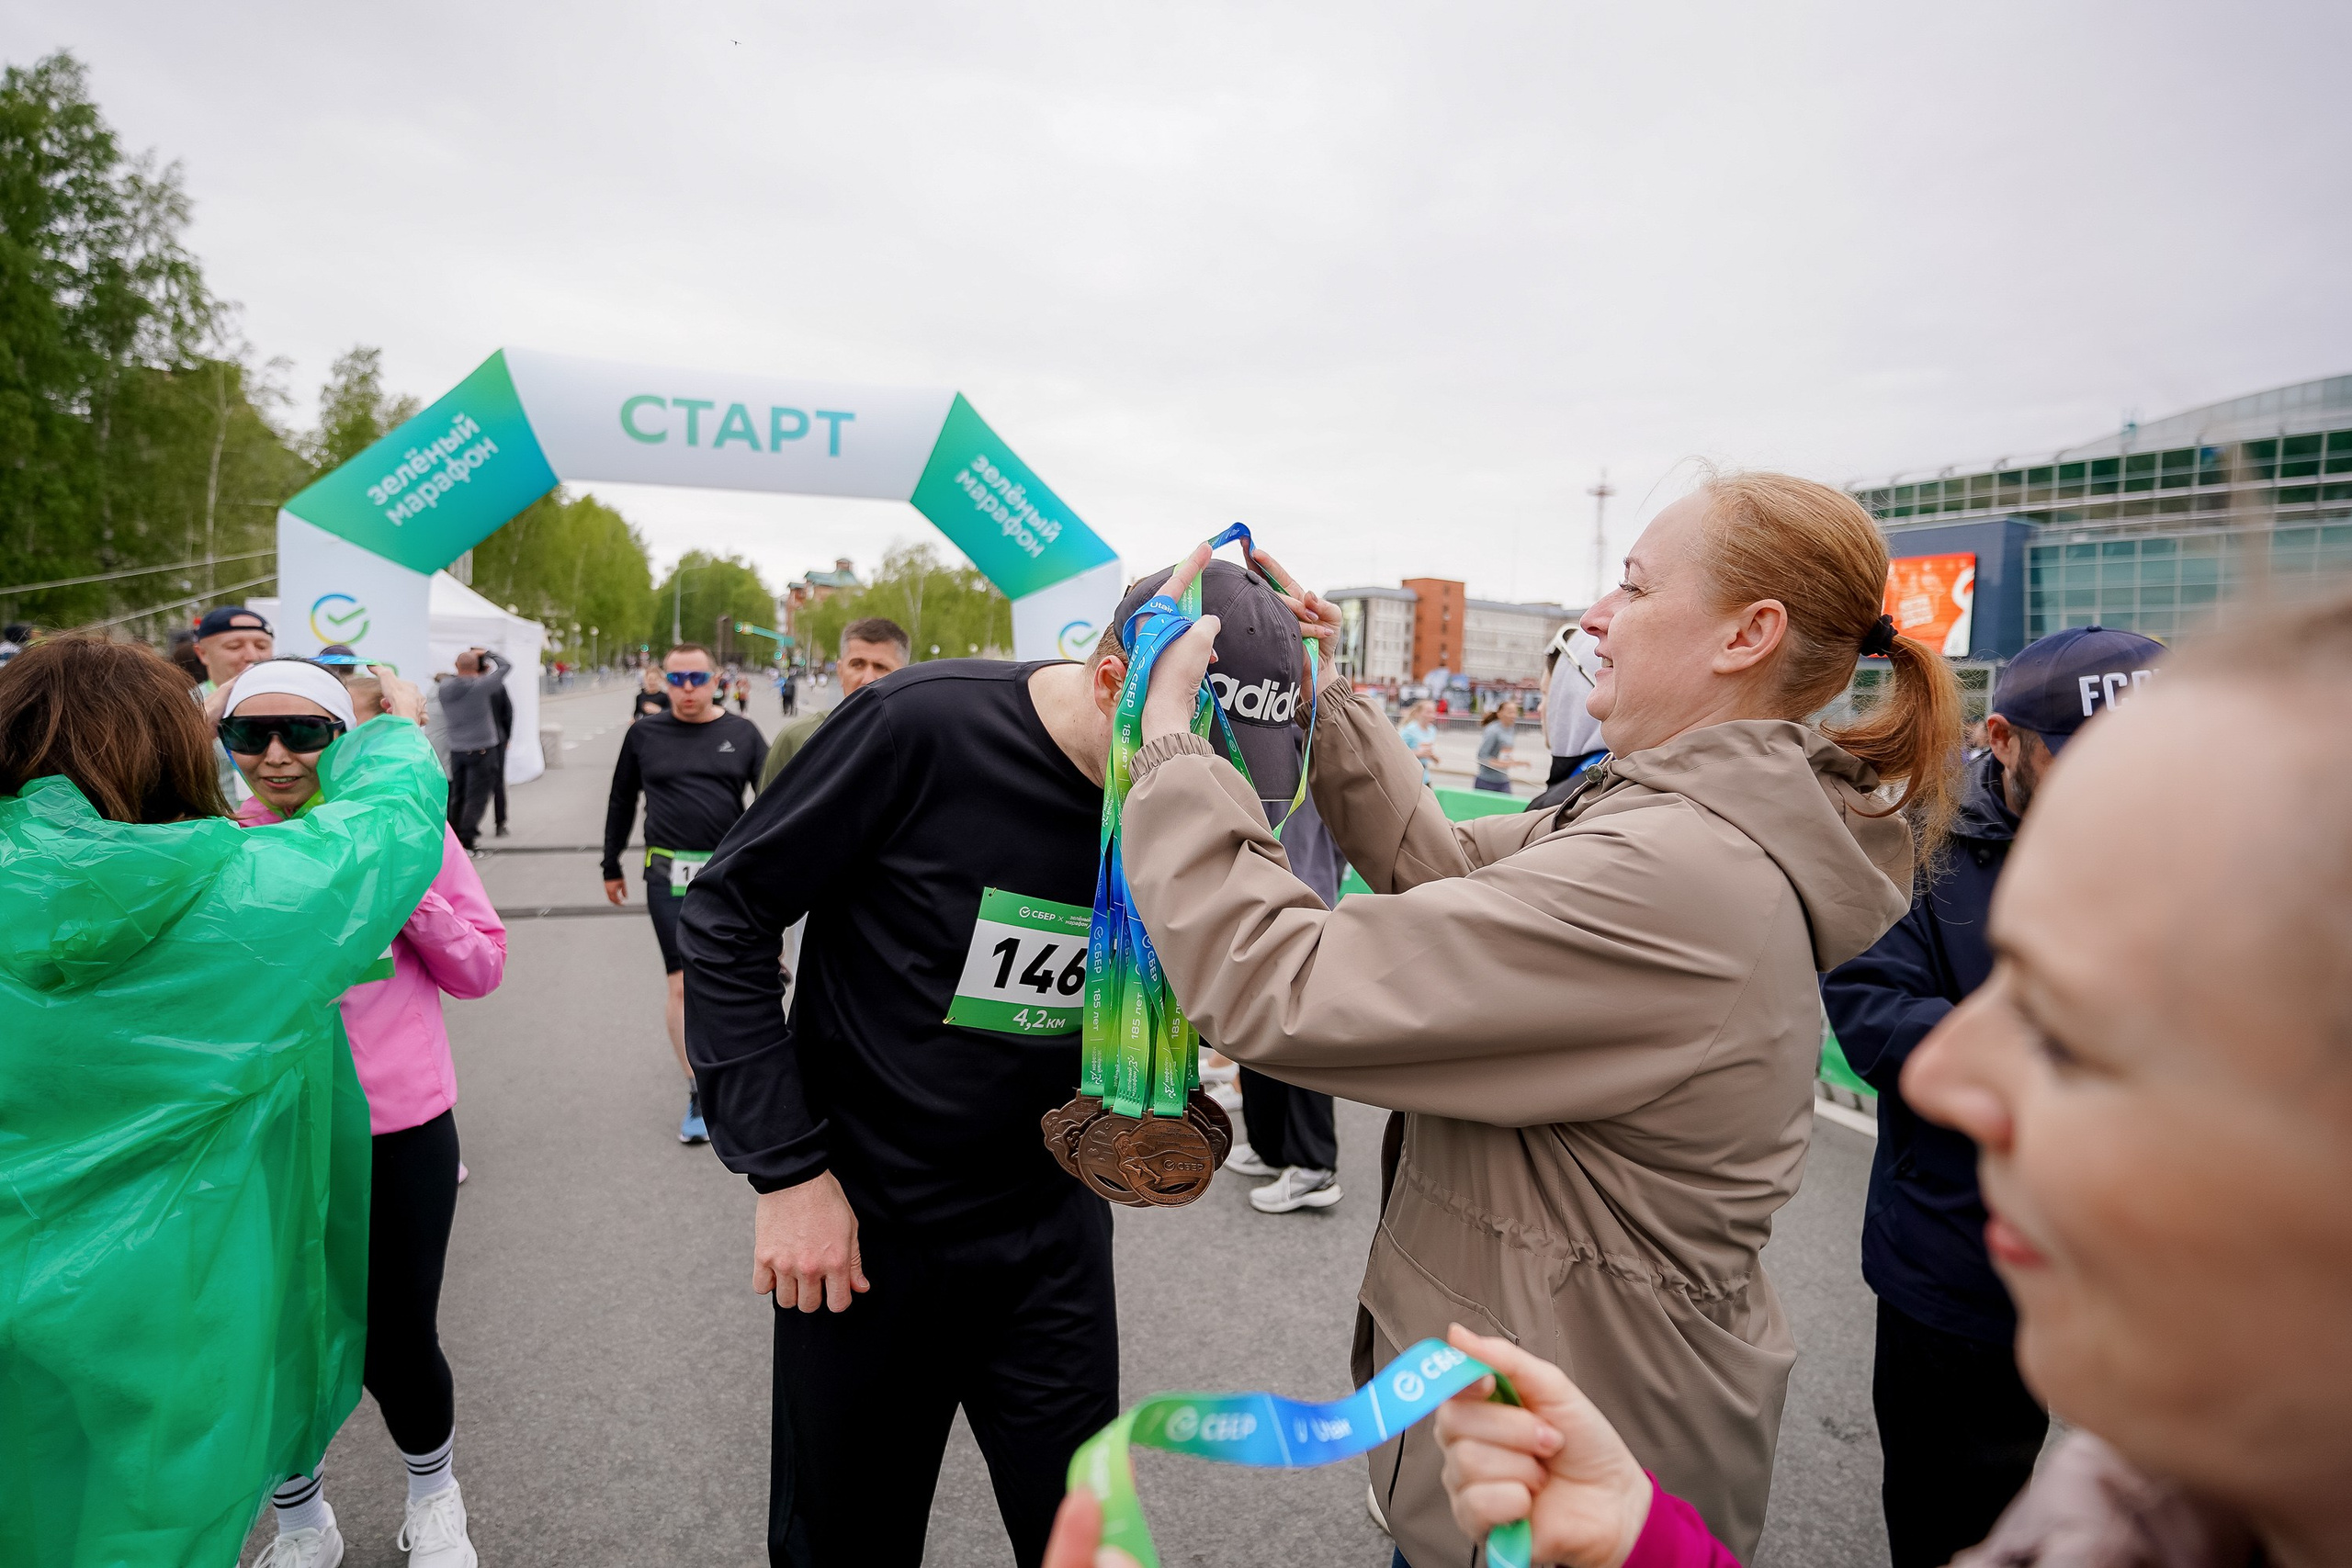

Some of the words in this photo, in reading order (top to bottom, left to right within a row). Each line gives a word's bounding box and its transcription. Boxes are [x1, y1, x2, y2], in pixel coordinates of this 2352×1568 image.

[620, 395, 855, 457] СТАРТ
[367, 412, 481, 506] зелёный
[386, 436, 500, 527] марафон
[955, 468, 1046, 558] марафон
[970, 454, 1063, 544] зелёный
[1149, 601, 1174, 615] Utair
[1125, 673, 1139, 709] СБЕР
[2078, 668, 2161, 717] FC
[1121, 722, 1132, 745] 185
[1121, 746, 1130, 772] лет
[1031, 909, 1057, 921] СБЕР
[991, 937, 1089, 997] 146
[1093, 942, 1102, 974] СБЕР
[1147, 950, 1158, 982] СБЕР
[1092, 987, 1102, 1009] 185
[1135, 992, 1143, 1016] лет
[1130, 1018, 1141, 1040] 185
[1170, 1018, 1181, 1039] 185
[1177, 1161, 1204, 1172] СБЕР
